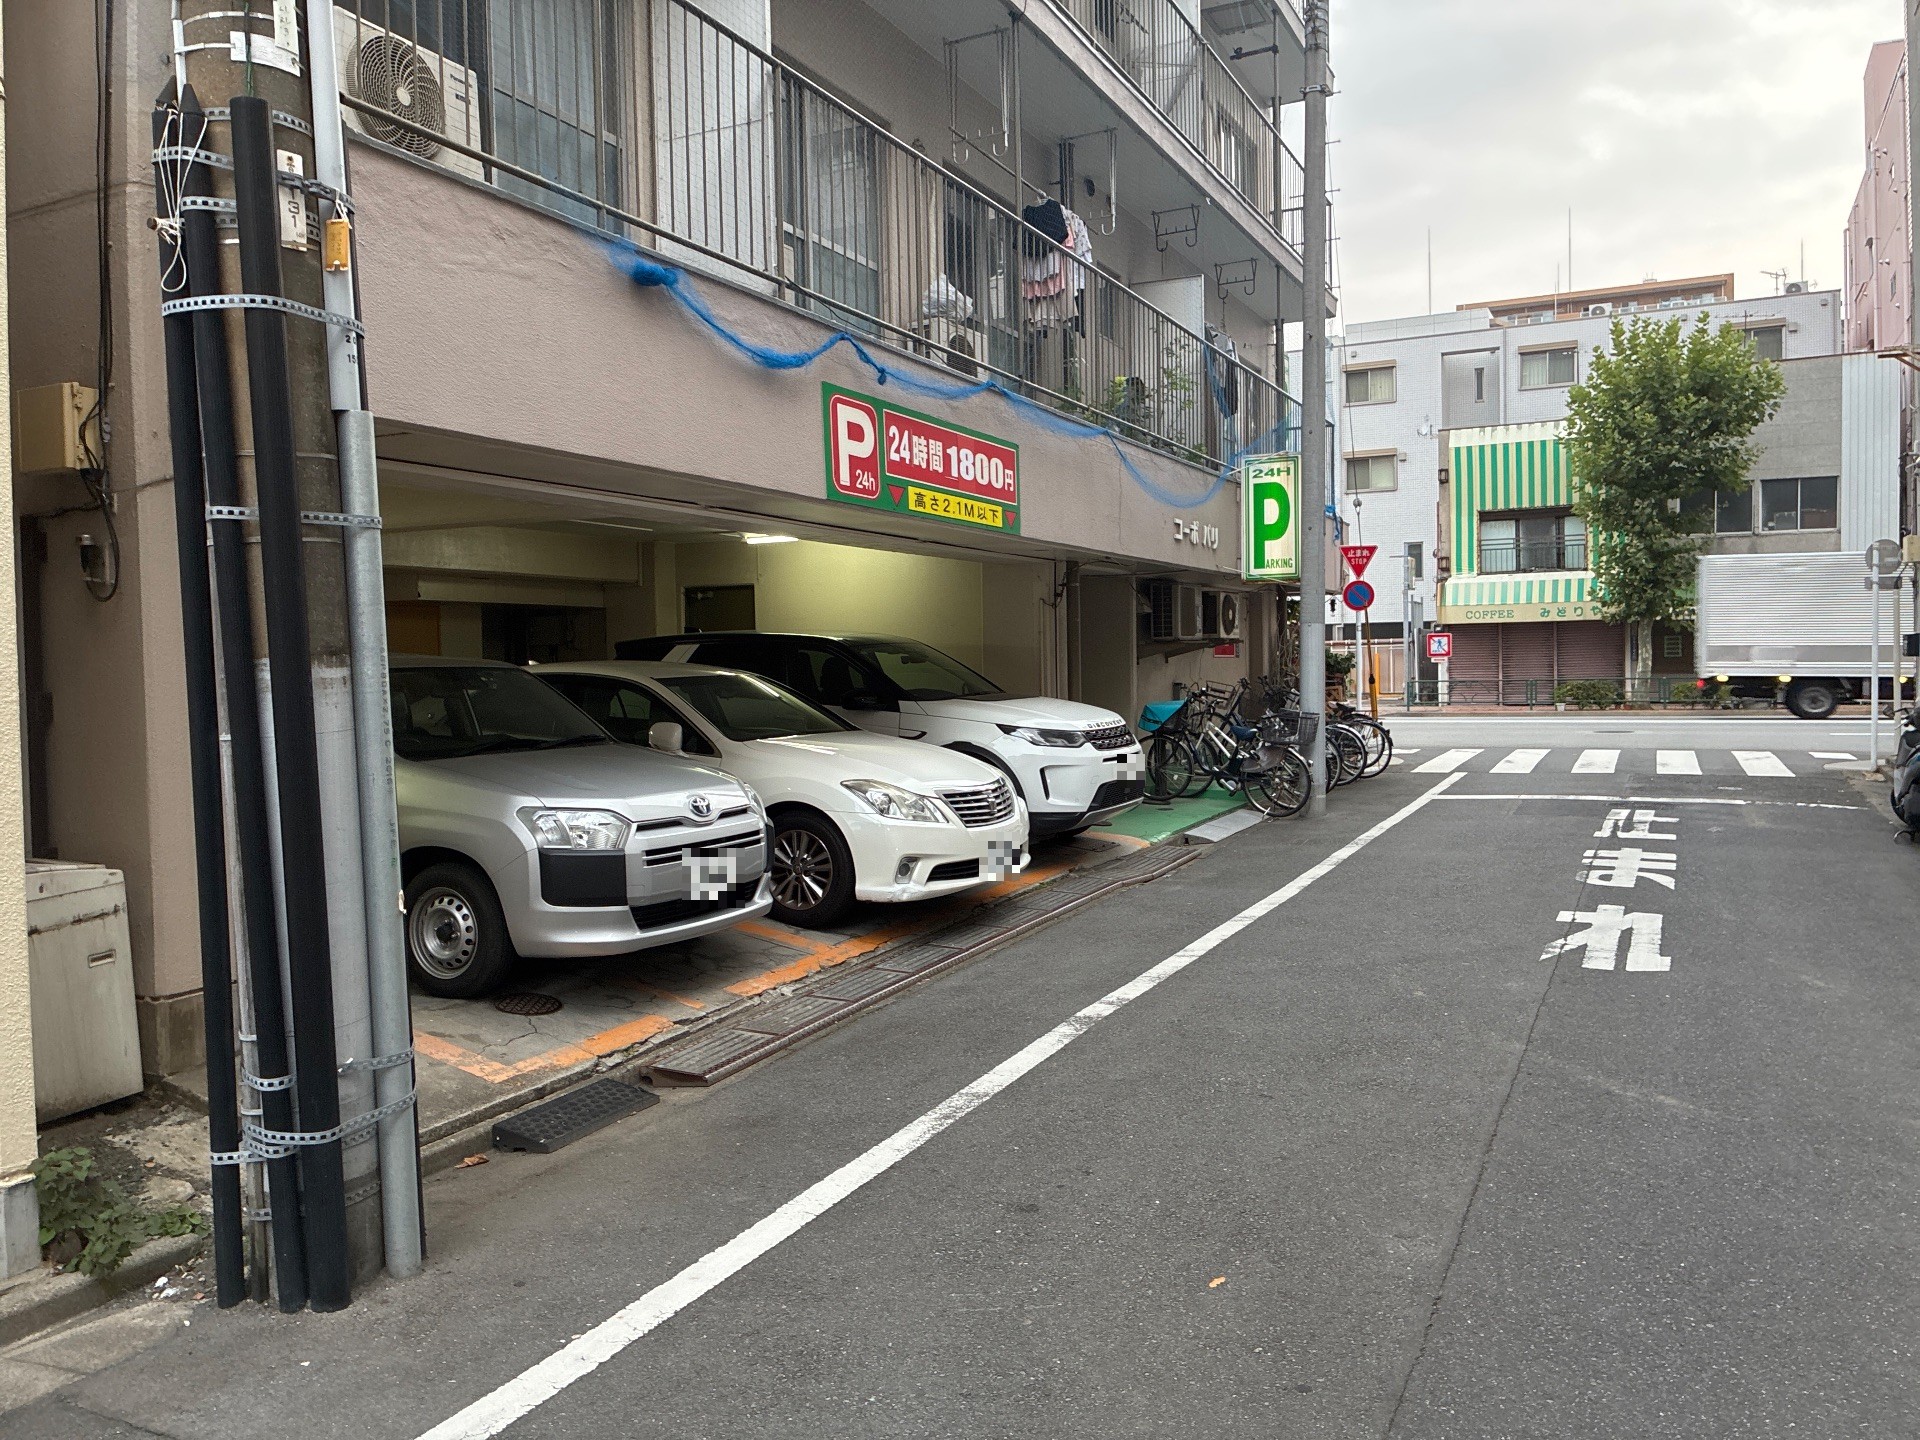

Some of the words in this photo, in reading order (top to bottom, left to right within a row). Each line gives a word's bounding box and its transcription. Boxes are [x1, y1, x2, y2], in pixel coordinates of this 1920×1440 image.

[837, 403, 875, 486] P
[856, 469, 876, 491] 24h
[1252, 467, 1291, 479] 24H
[914, 492, 999, 523] 高さ2.1M以下
[1347, 549, 1371, 557] 止まれ
[1465, 610, 1515, 620] COFFEE
[1086, 719, 1123, 729] DISCOVERY
